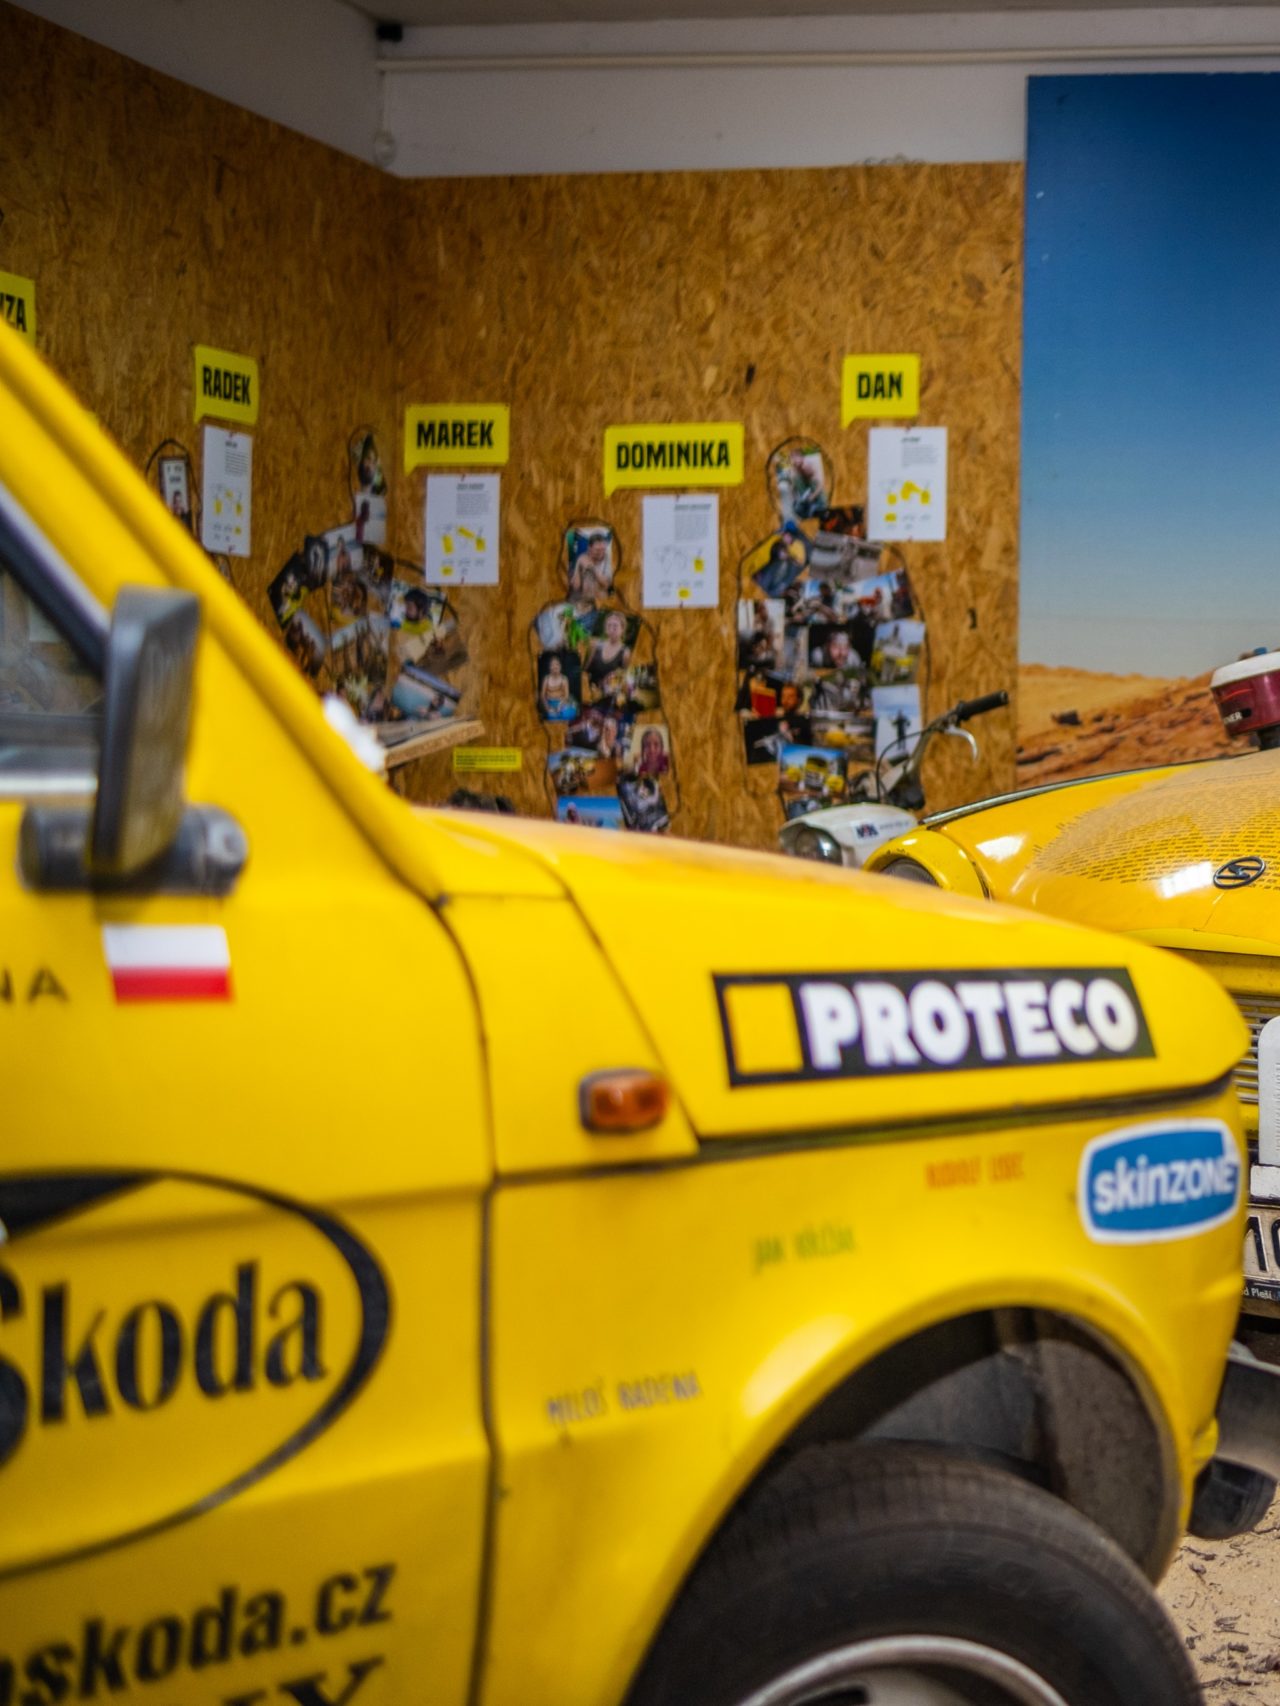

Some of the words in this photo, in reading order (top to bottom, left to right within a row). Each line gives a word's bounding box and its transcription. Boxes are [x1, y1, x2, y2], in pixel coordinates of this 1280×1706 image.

[203, 366, 251, 405] RADEK
[857, 372, 903, 399] DAN
[416, 419, 495, 449] MAREK
[616, 440, 730, 470] DOMINIKA
[800, 978, 1138, 1070] PROTECO
